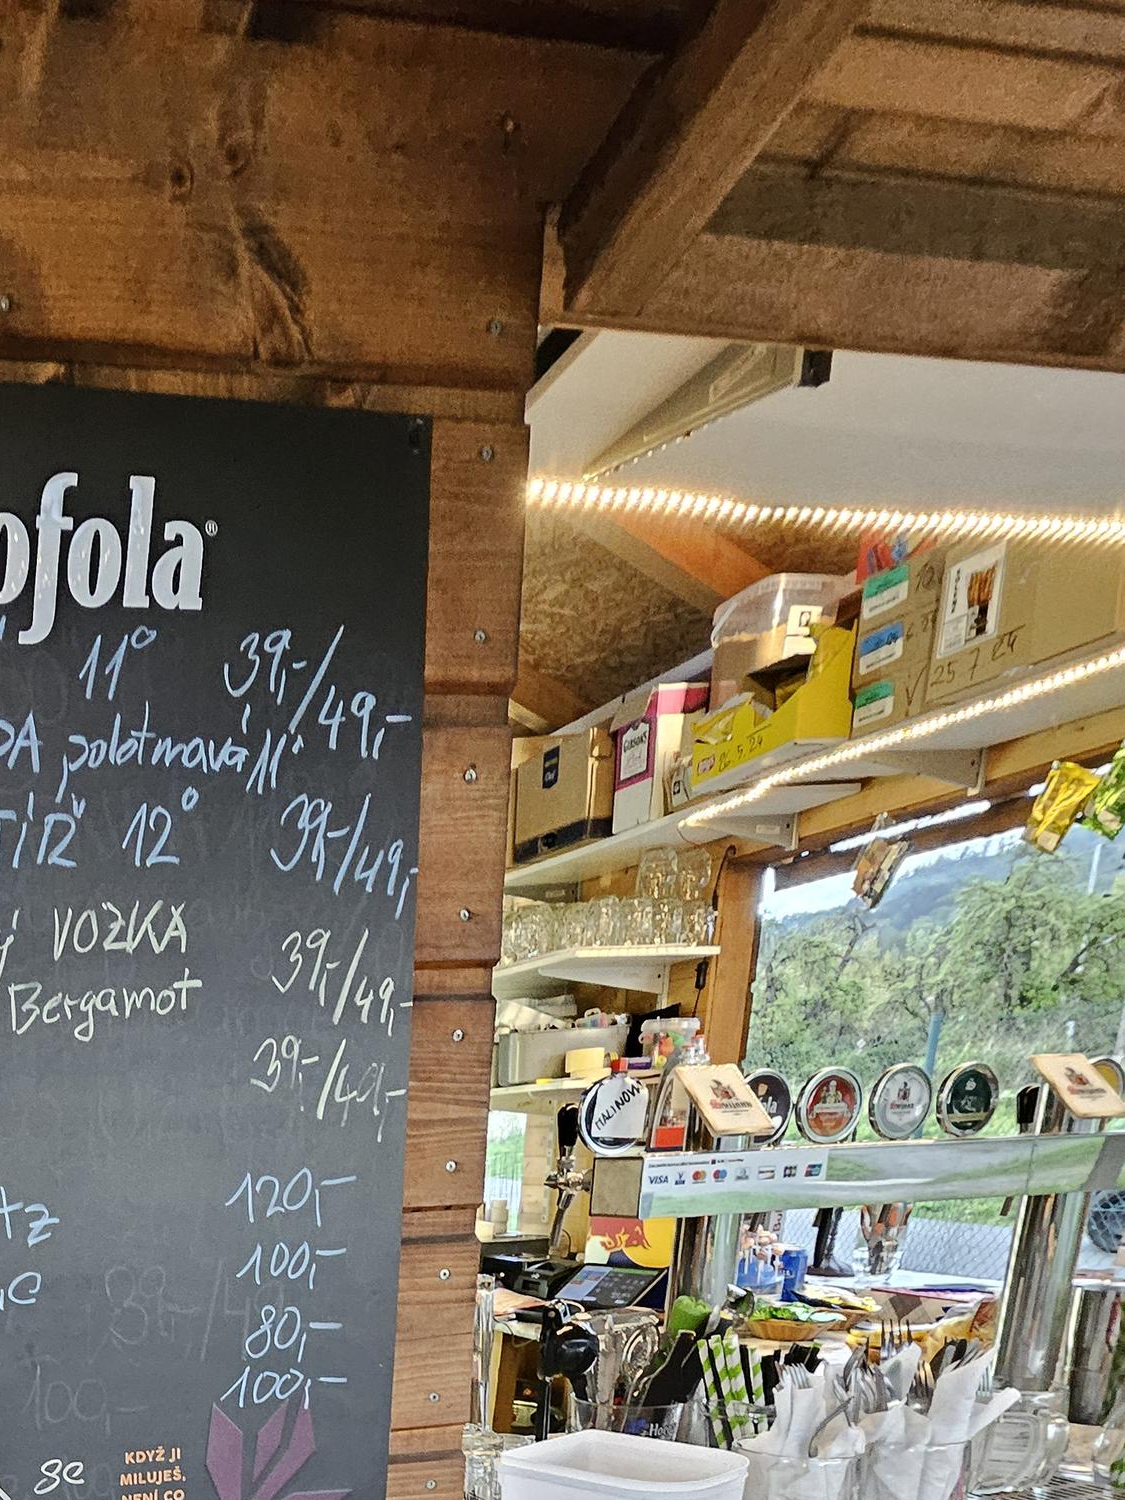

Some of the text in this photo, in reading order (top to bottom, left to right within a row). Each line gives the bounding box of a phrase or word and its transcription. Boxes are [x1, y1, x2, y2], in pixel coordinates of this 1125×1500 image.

[122, 785, 200, 868] 12°
[8, 966, 204, 1043] Bergamot
[32, 1456, 88, 1497] se
[124, 1445, 182, 1465] KDYŽ JI
